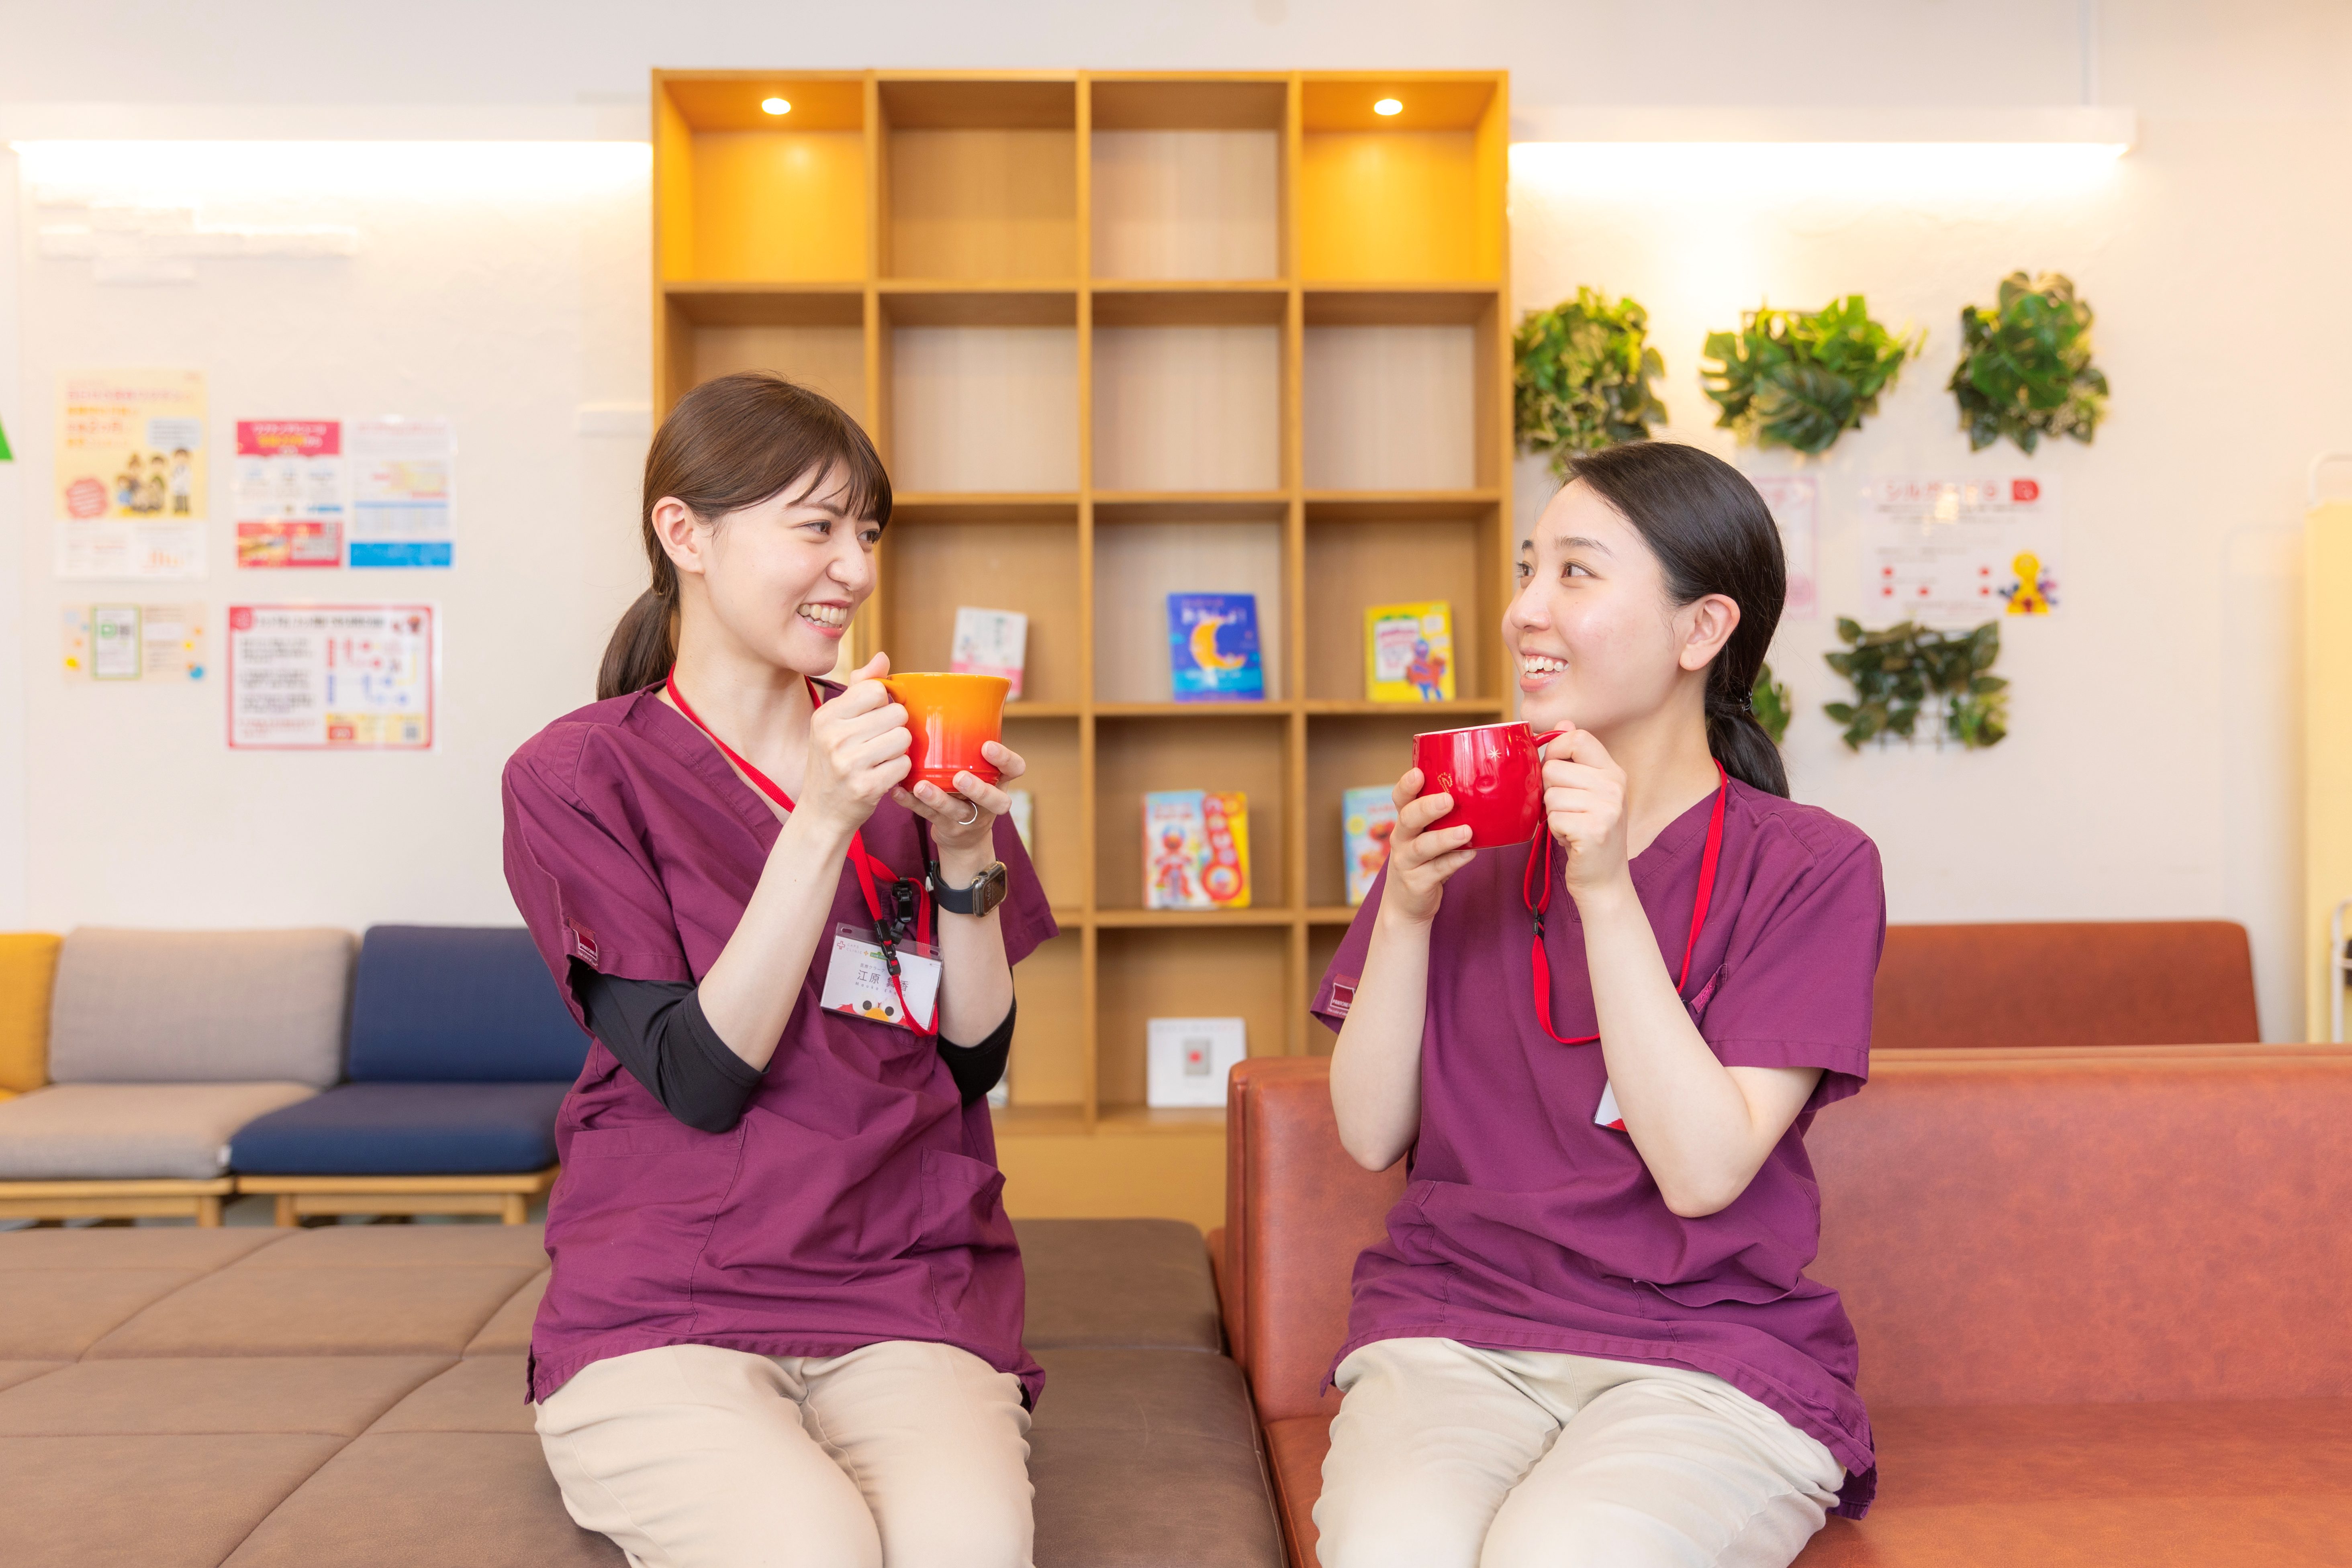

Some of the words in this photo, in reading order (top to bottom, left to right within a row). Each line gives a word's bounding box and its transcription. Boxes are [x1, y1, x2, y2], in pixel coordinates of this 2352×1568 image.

[860, 963, 885, 972] 医療クラーク
[857, 970, 881, 984] 江原
[885, 989, 905, 997] Ehaa
[1700, 982, 1712, 1000] FOLK
